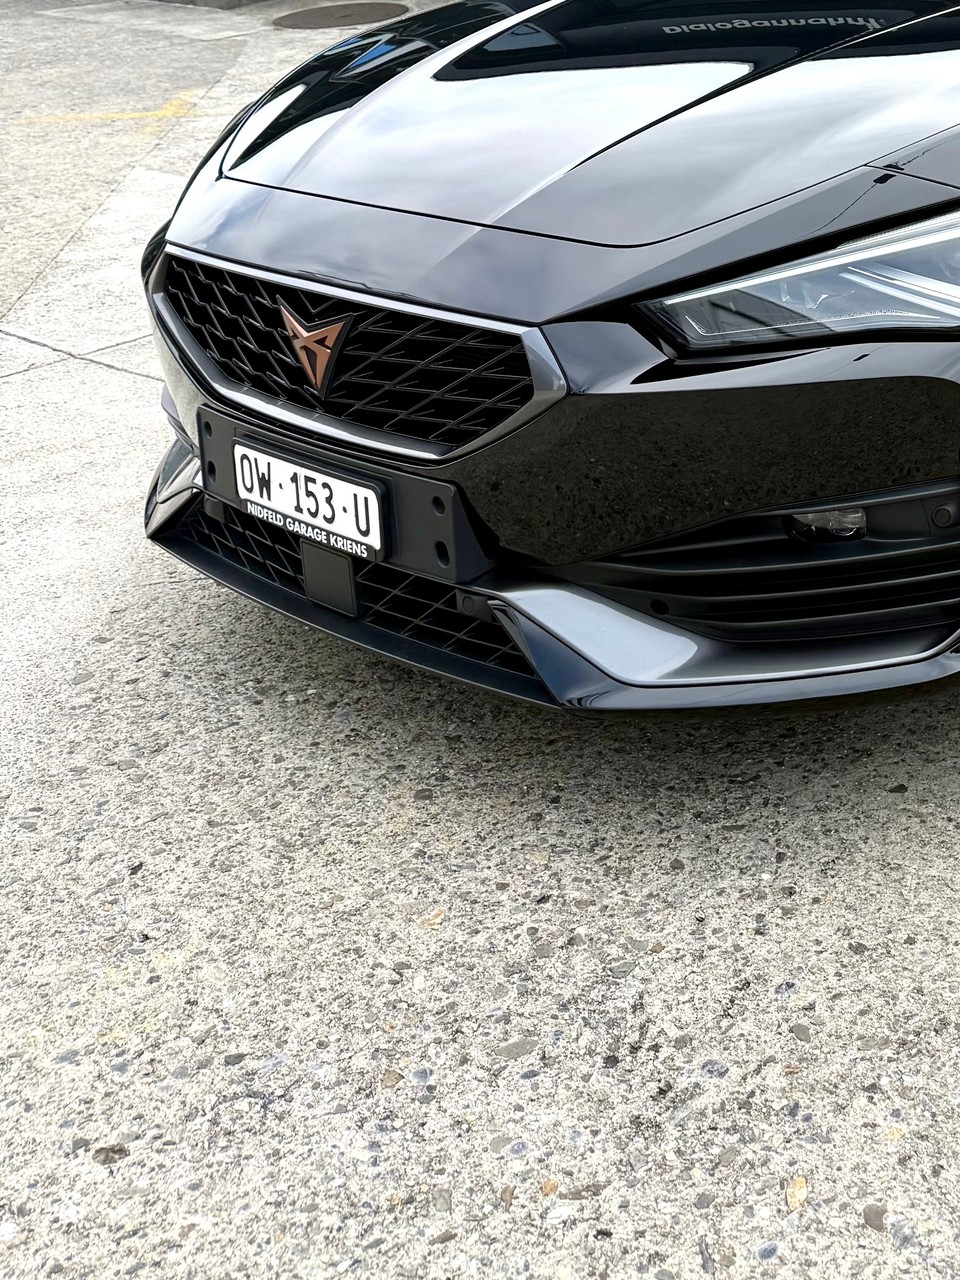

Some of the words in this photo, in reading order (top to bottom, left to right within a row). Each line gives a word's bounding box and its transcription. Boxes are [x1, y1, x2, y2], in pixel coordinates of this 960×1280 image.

[247, 501, 284, 526] NIDFELD
[286, 518, 328, 544] GARAGE
[329, 534, 368, 558] KRIENS
